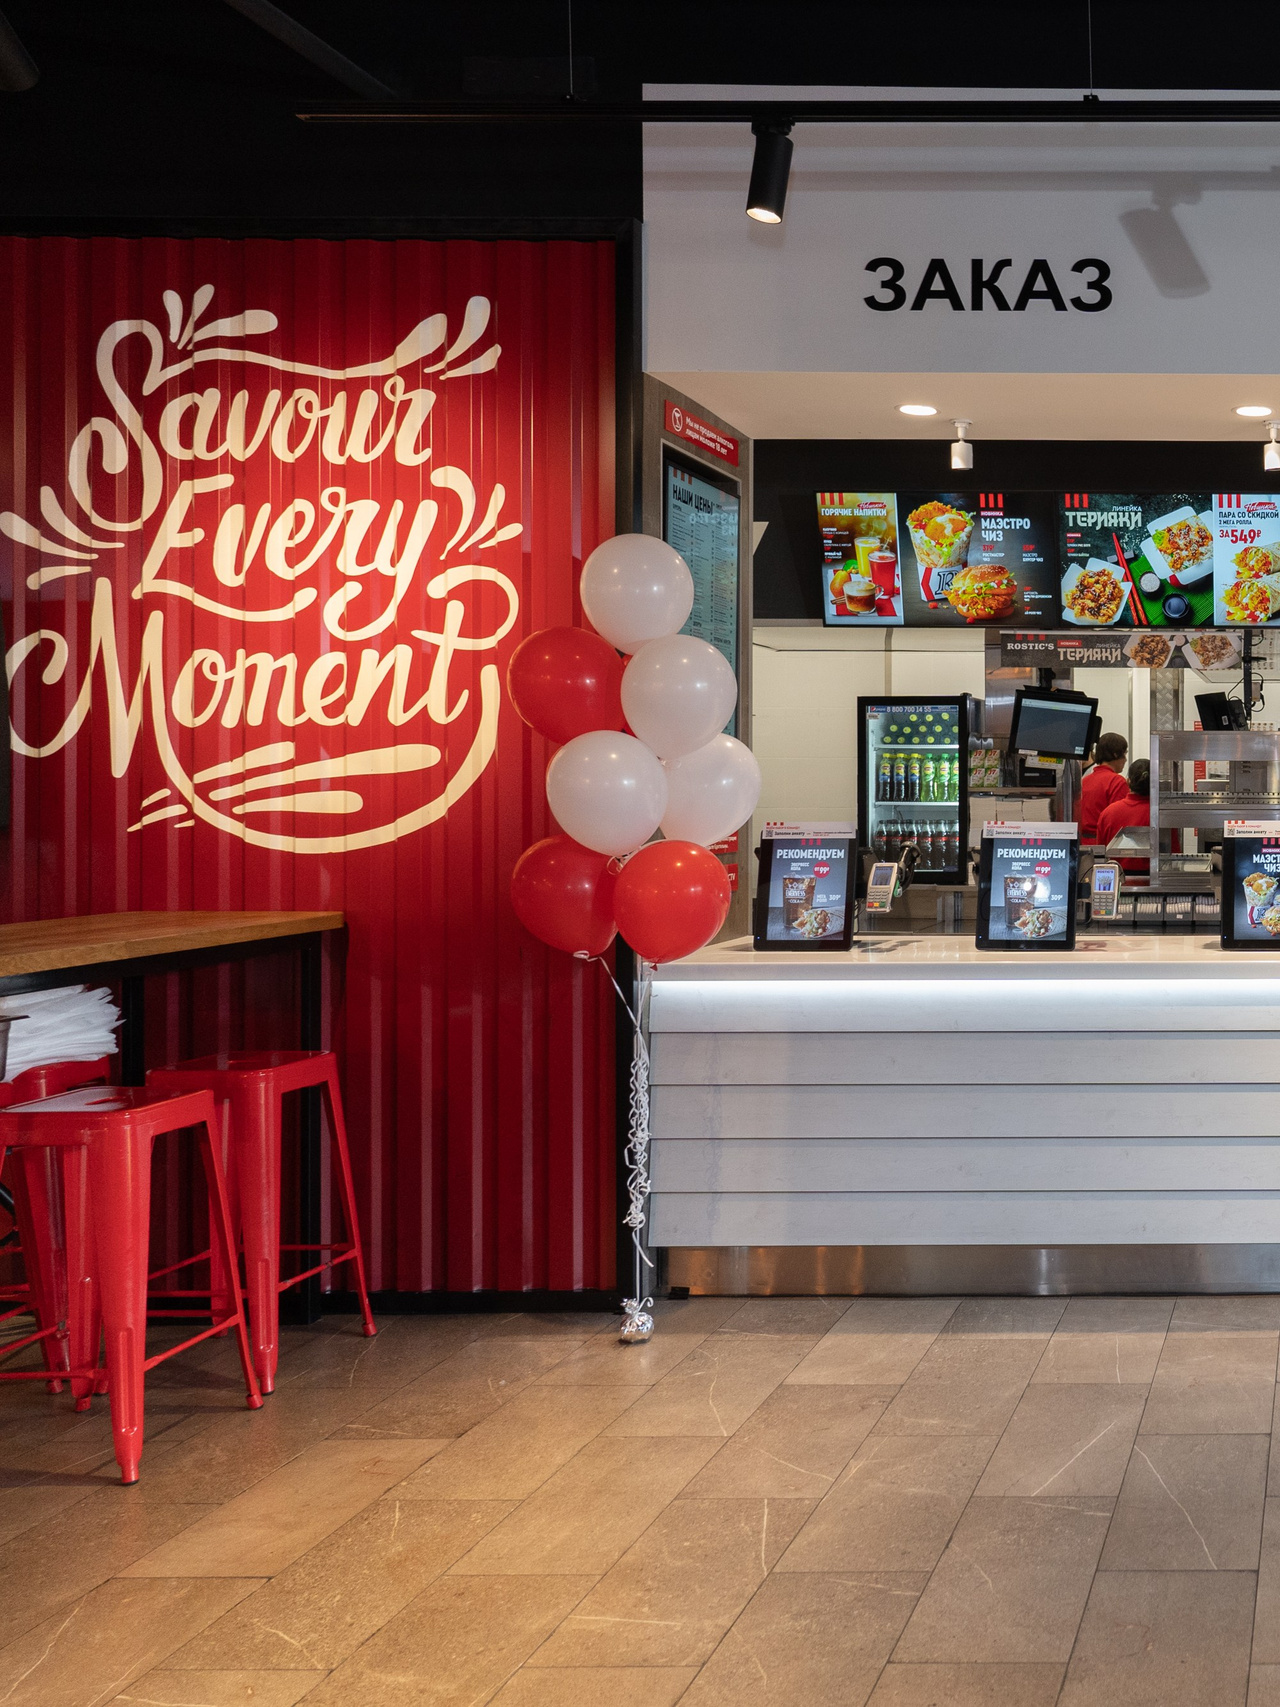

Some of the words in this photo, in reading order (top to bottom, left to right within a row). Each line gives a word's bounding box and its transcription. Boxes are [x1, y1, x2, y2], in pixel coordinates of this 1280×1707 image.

[863, 257, 1113, 312] ЗАКАЗ
[69, 318, 446, 531] Savour
[672, 484, 693, 508] НАШИ
[821, 508, 852, 516] ГОРЯЧИЕ
[853, 508, 887, 516] НАПИТКИ
[1112, 504, 1143, 512] ЛИНЕЙКА
[1247, 509, 1279, 519] СКИДКОЙ
[981, 518, 1031, 530] МАЭСТРО
[1065, 511, 1142, 530] ТЕРИЯКИ
[981, 530, 1004, 541] ЧИЗ
[1219, 529, 1229, 538] ЗА
[132, 473, 440, 641] Every
[1058, 648, 1121, 664] ТЕРИЯКИ
[4, 566, 519, 780] Moment
[776, 849, 845, 861] РЕКОМЕНДУЕМ
[997, 848, 1066, 860] РЕКОМЕНДУЕМ
